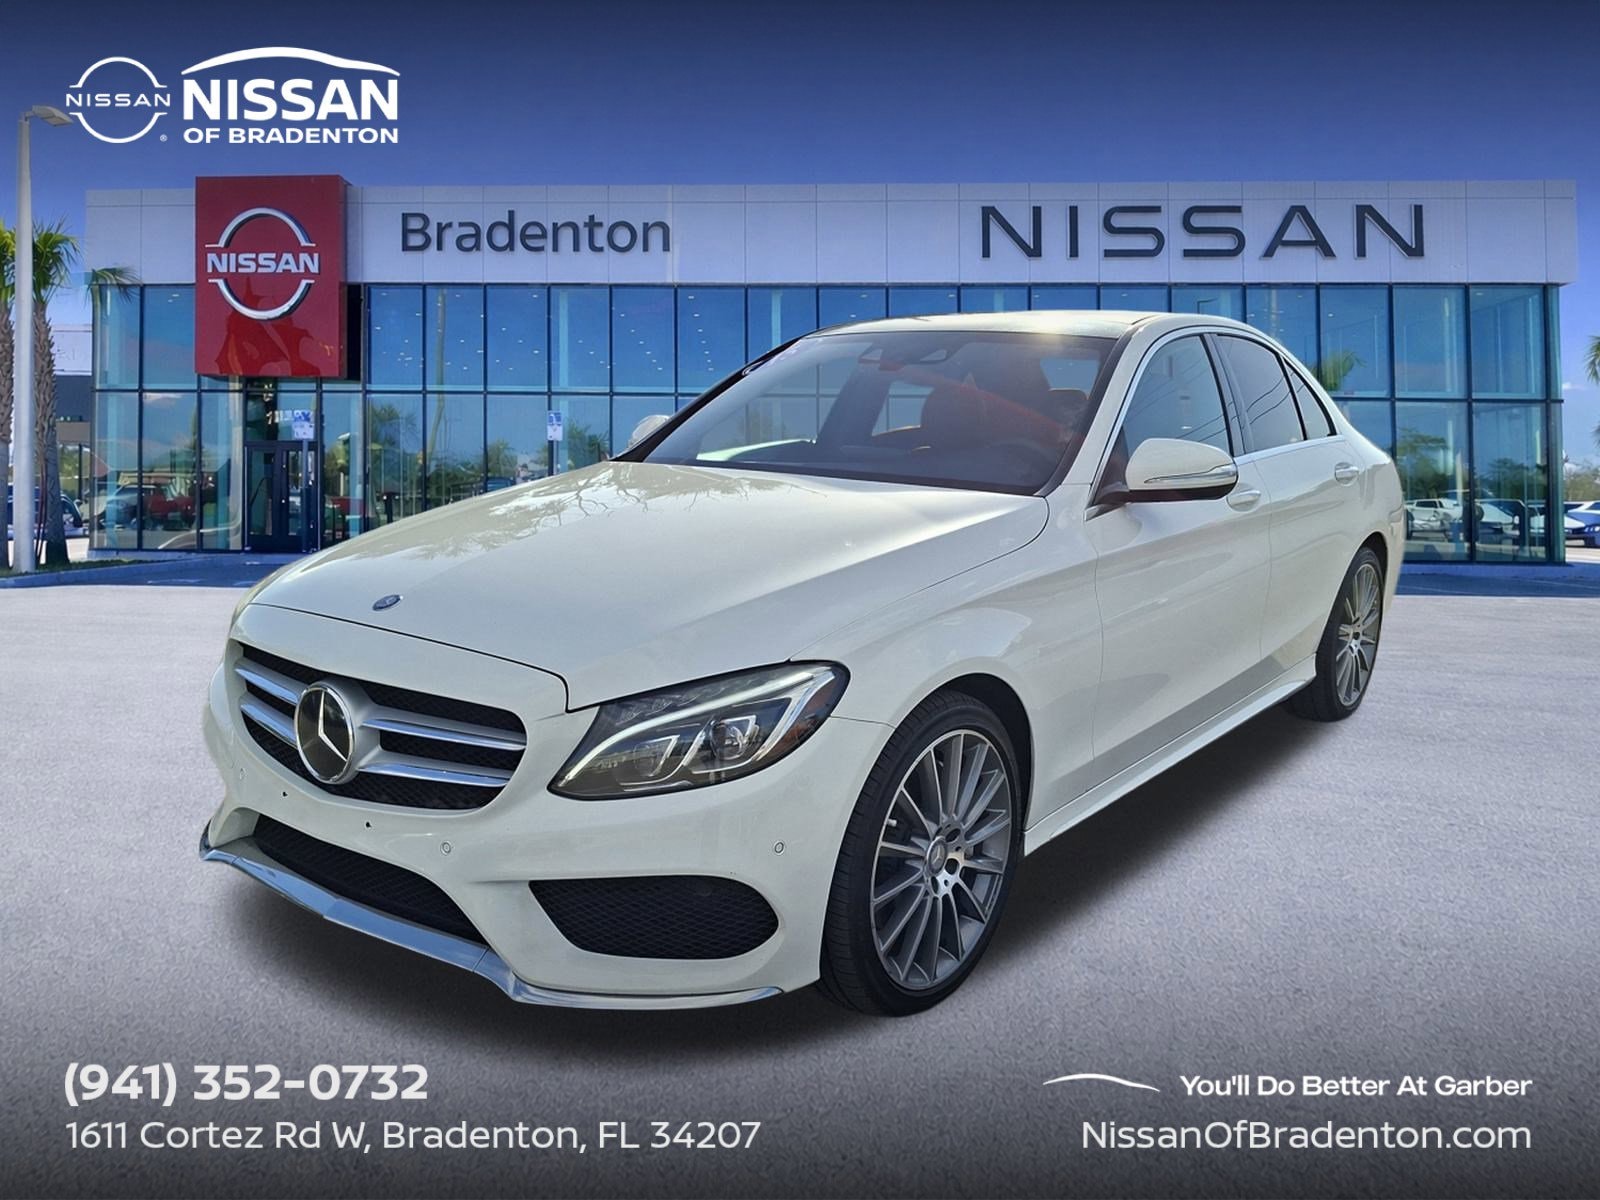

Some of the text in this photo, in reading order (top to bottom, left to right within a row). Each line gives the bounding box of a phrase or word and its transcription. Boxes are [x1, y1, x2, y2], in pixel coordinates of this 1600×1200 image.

[401, 210, 671, 252] Bradenton
[981, 204, 1425, 259] NISSAN
[206, 252, 319, 273] NISSAN
